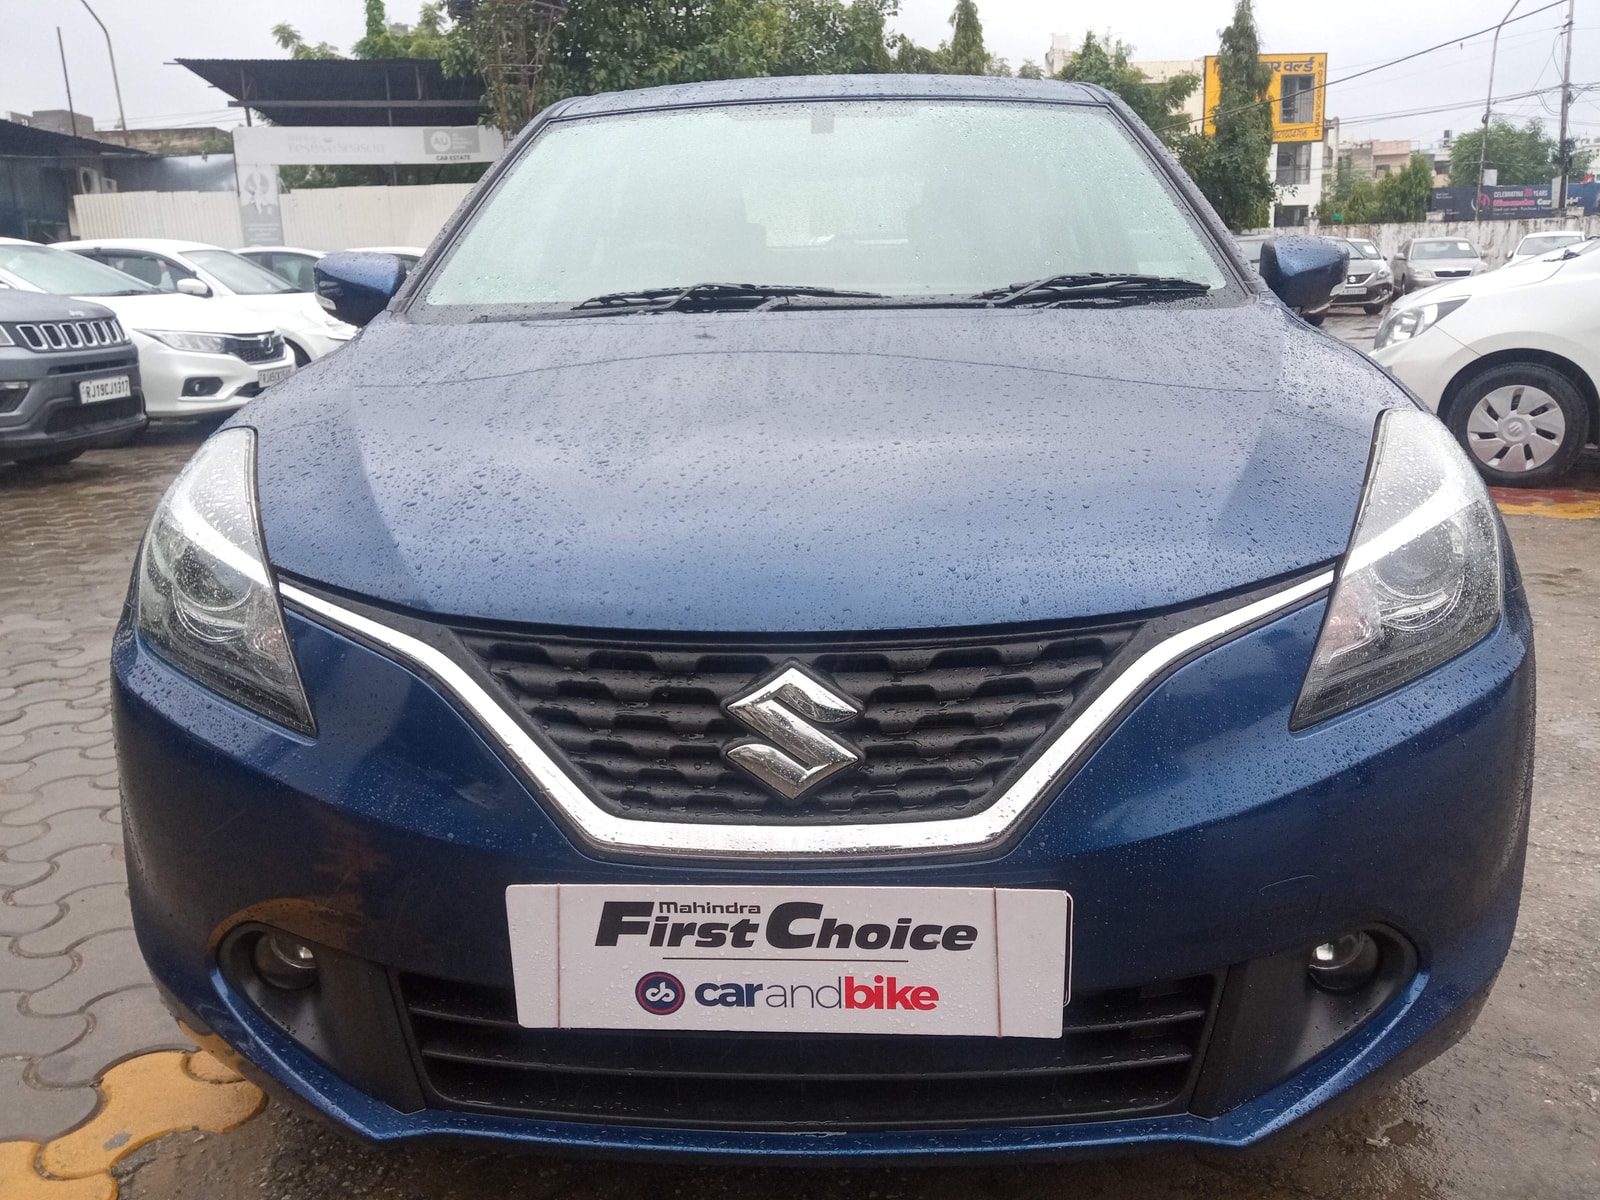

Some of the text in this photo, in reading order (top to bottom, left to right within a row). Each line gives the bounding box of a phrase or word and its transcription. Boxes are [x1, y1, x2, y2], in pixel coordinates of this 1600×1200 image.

[433, 136, 449, 146] AU
[658, 901, 761, 914] Mahindra
[594, 901, 978, 951] First Choice
